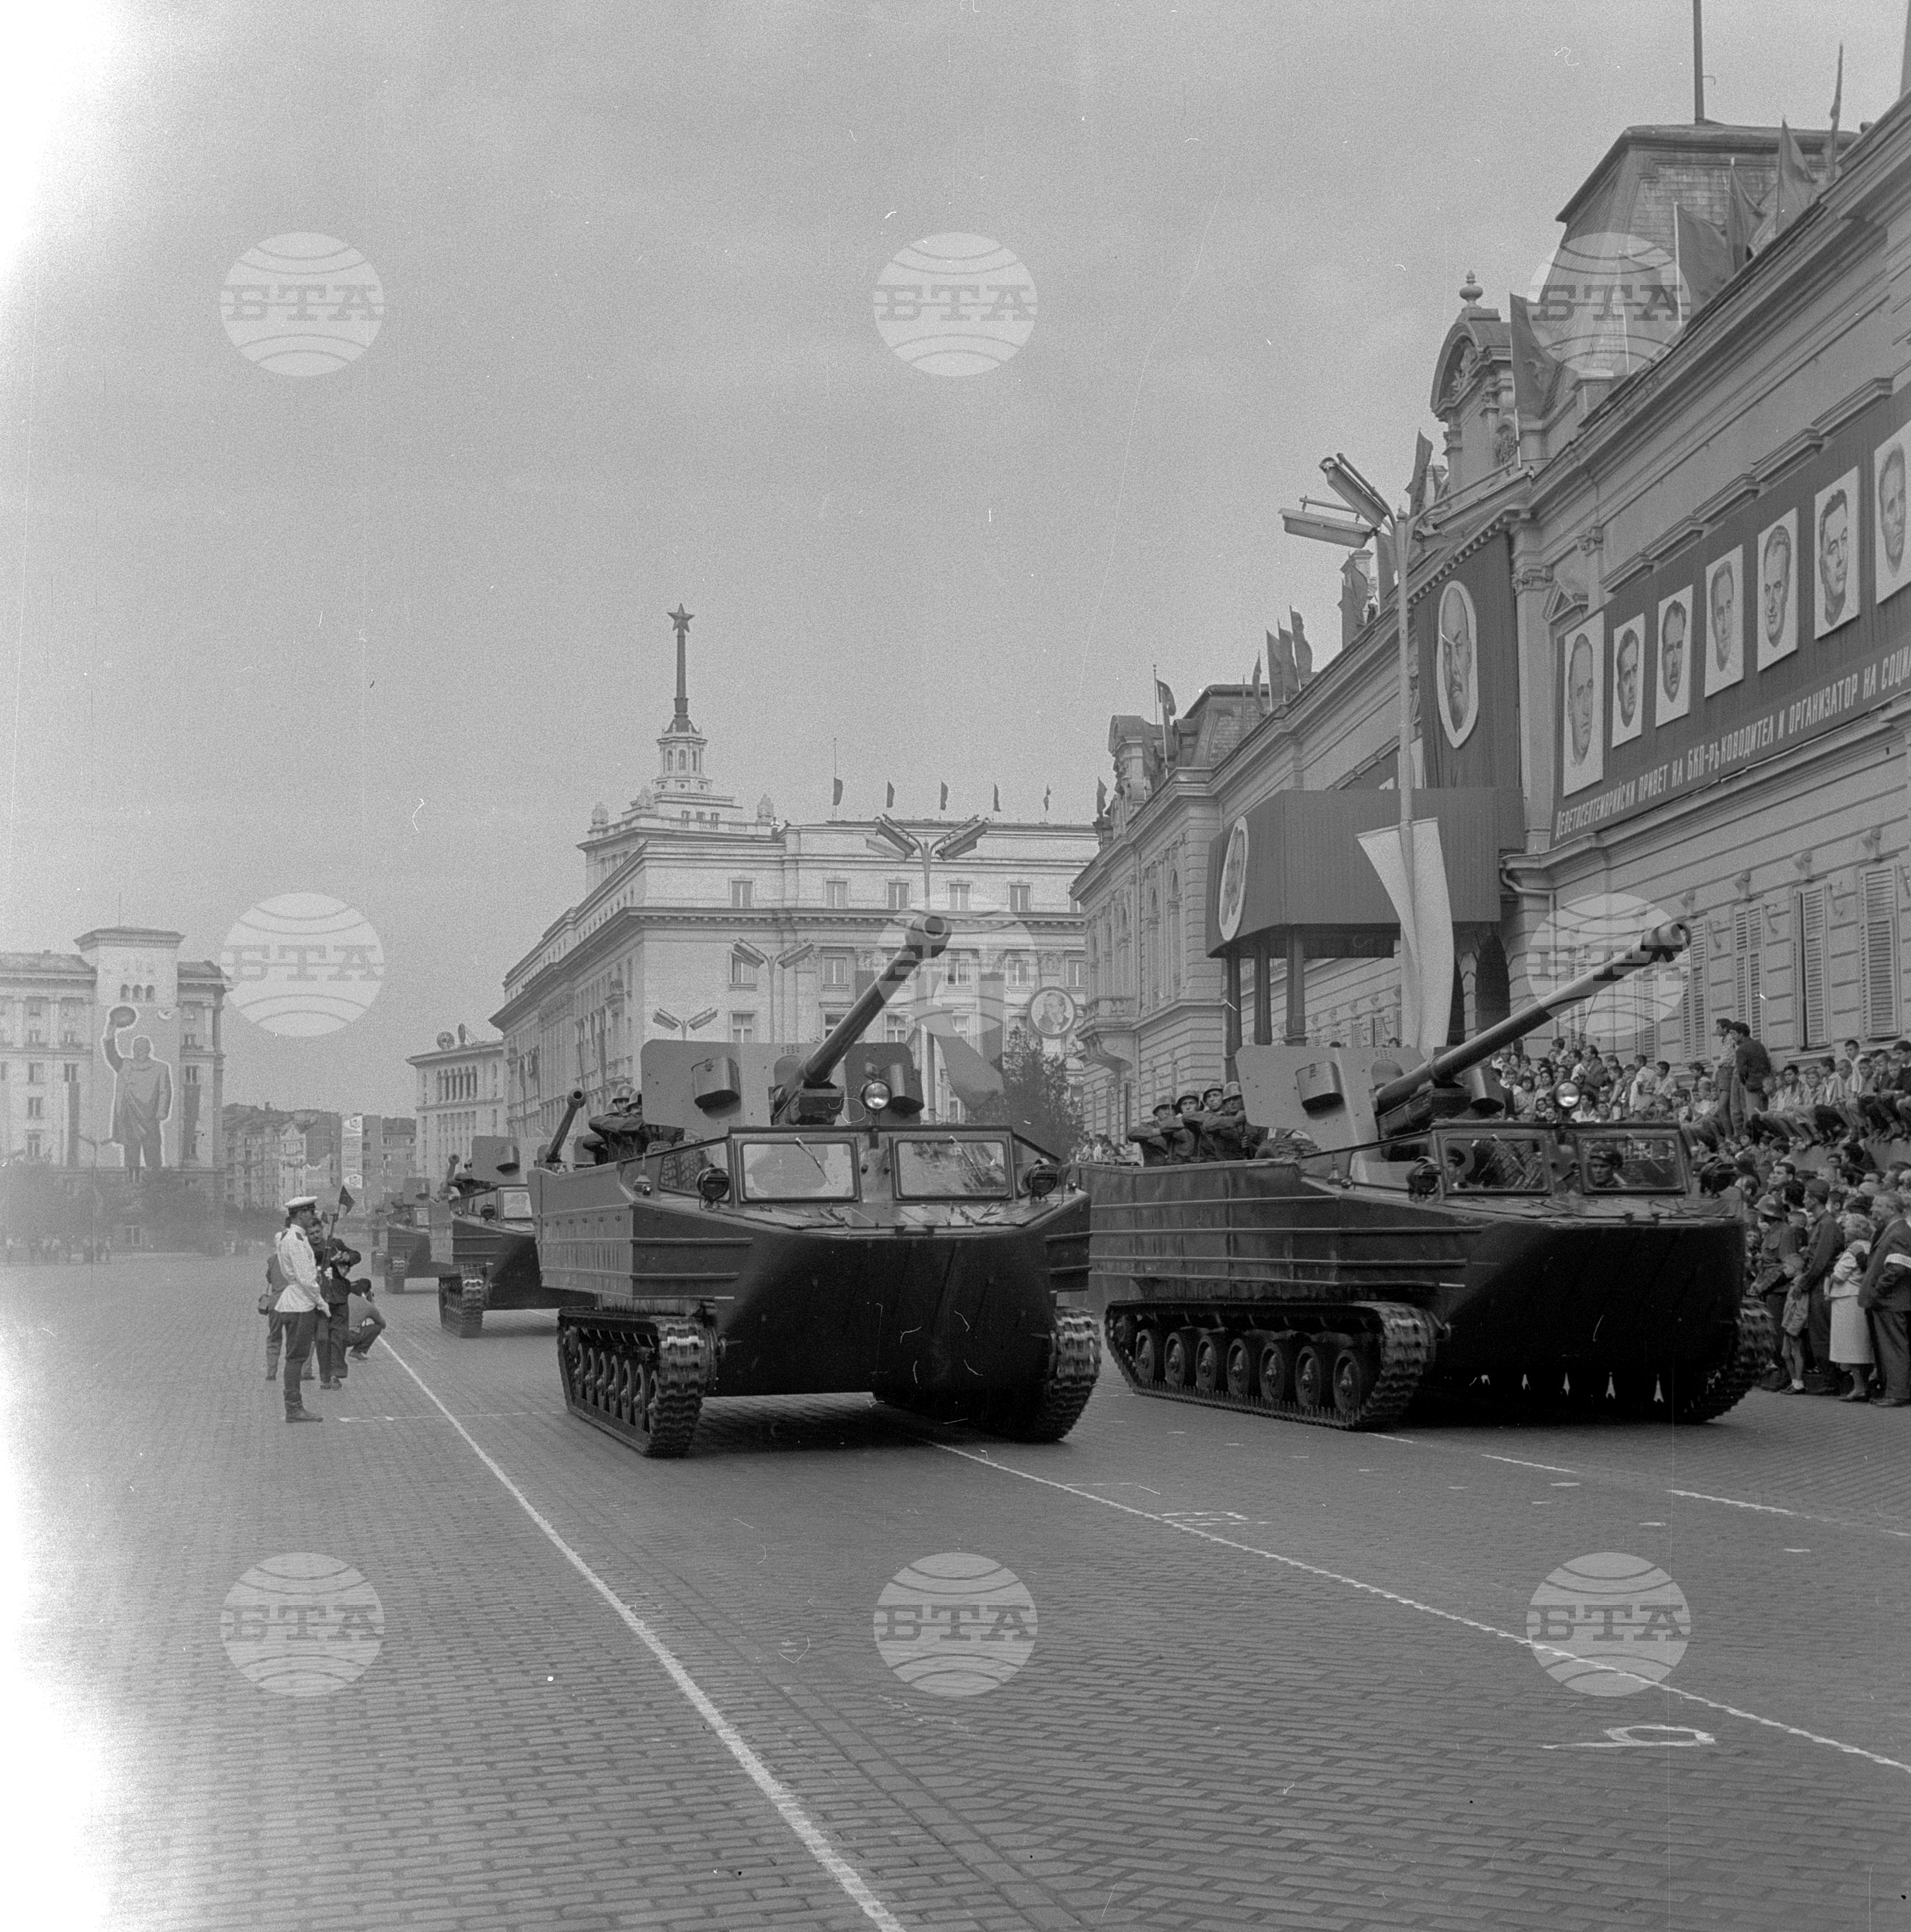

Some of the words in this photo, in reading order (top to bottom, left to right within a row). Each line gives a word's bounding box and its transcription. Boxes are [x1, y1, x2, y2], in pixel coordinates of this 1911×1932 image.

[1638, 765, 1668, 802] ПРИВЕТ
[1671, 758, 1683, 787] НА
[1778, 709, 1785, 739] И
[1789, 673, 1858, 734] ОРГАНИЗАТОР
[1863, 663, 1876, 700] НА
